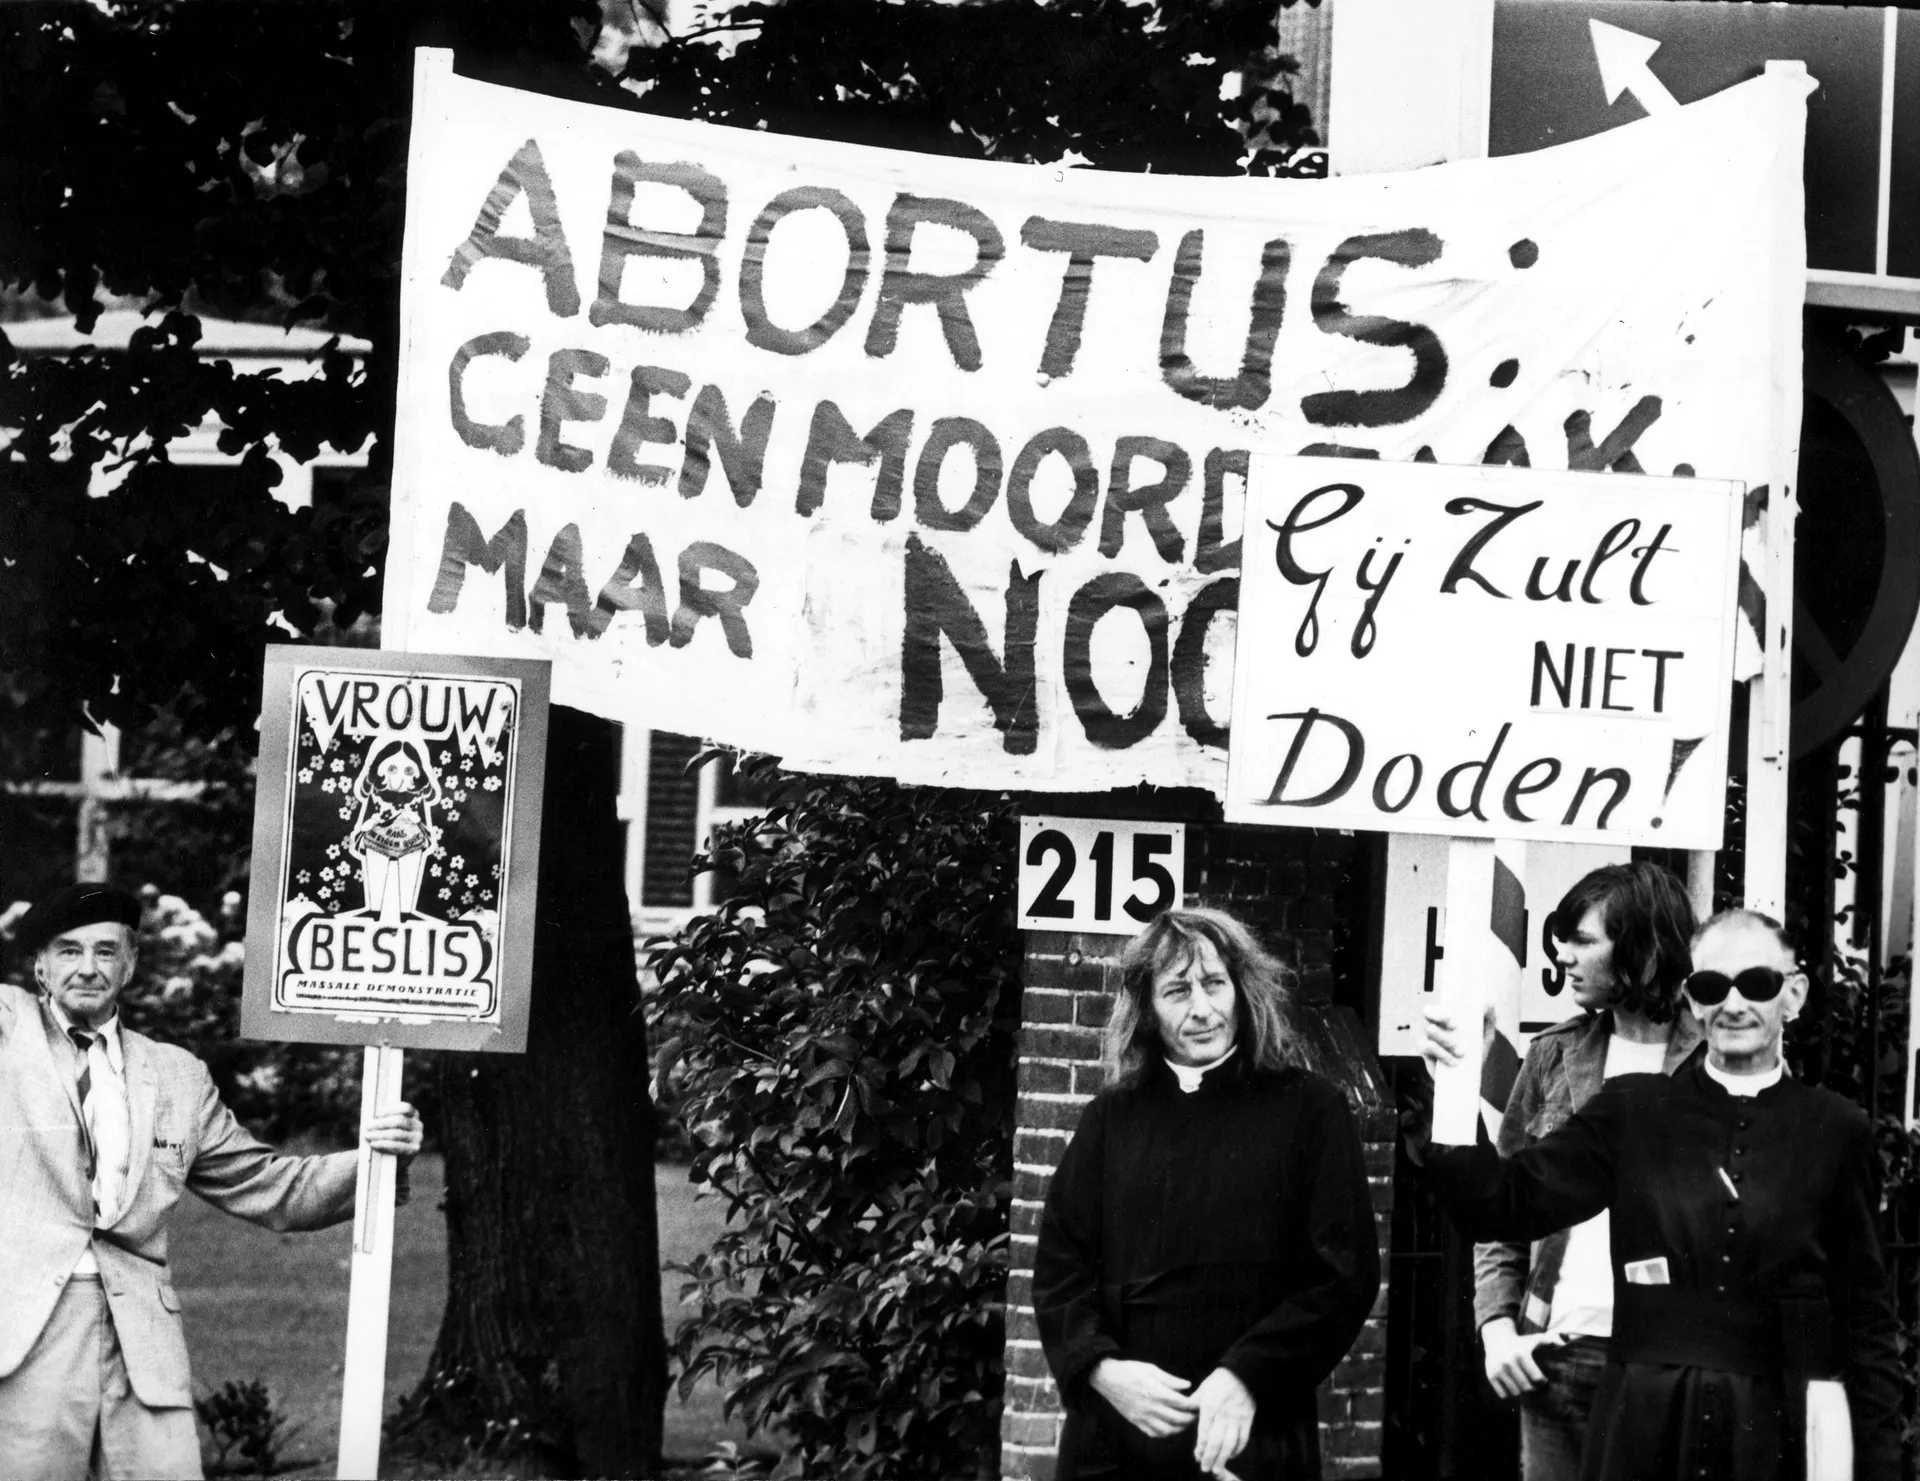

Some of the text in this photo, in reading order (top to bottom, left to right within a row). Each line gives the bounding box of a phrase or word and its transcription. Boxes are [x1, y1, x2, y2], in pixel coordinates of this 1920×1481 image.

[427, 501, 760, 660] MAAR
[1264, 483, 1412, 660] Gij
[1439, 497, 1681, 606] Zult
[316, 679, 498, 734] VROUW
[1531, 640, 1685, 713] NIET
[1025, 829, 1177, 923] 215
[310, 924, 470, 978] BESLIS
[297, 980, 478, 997] MASSALE DEMONSTRATIE
